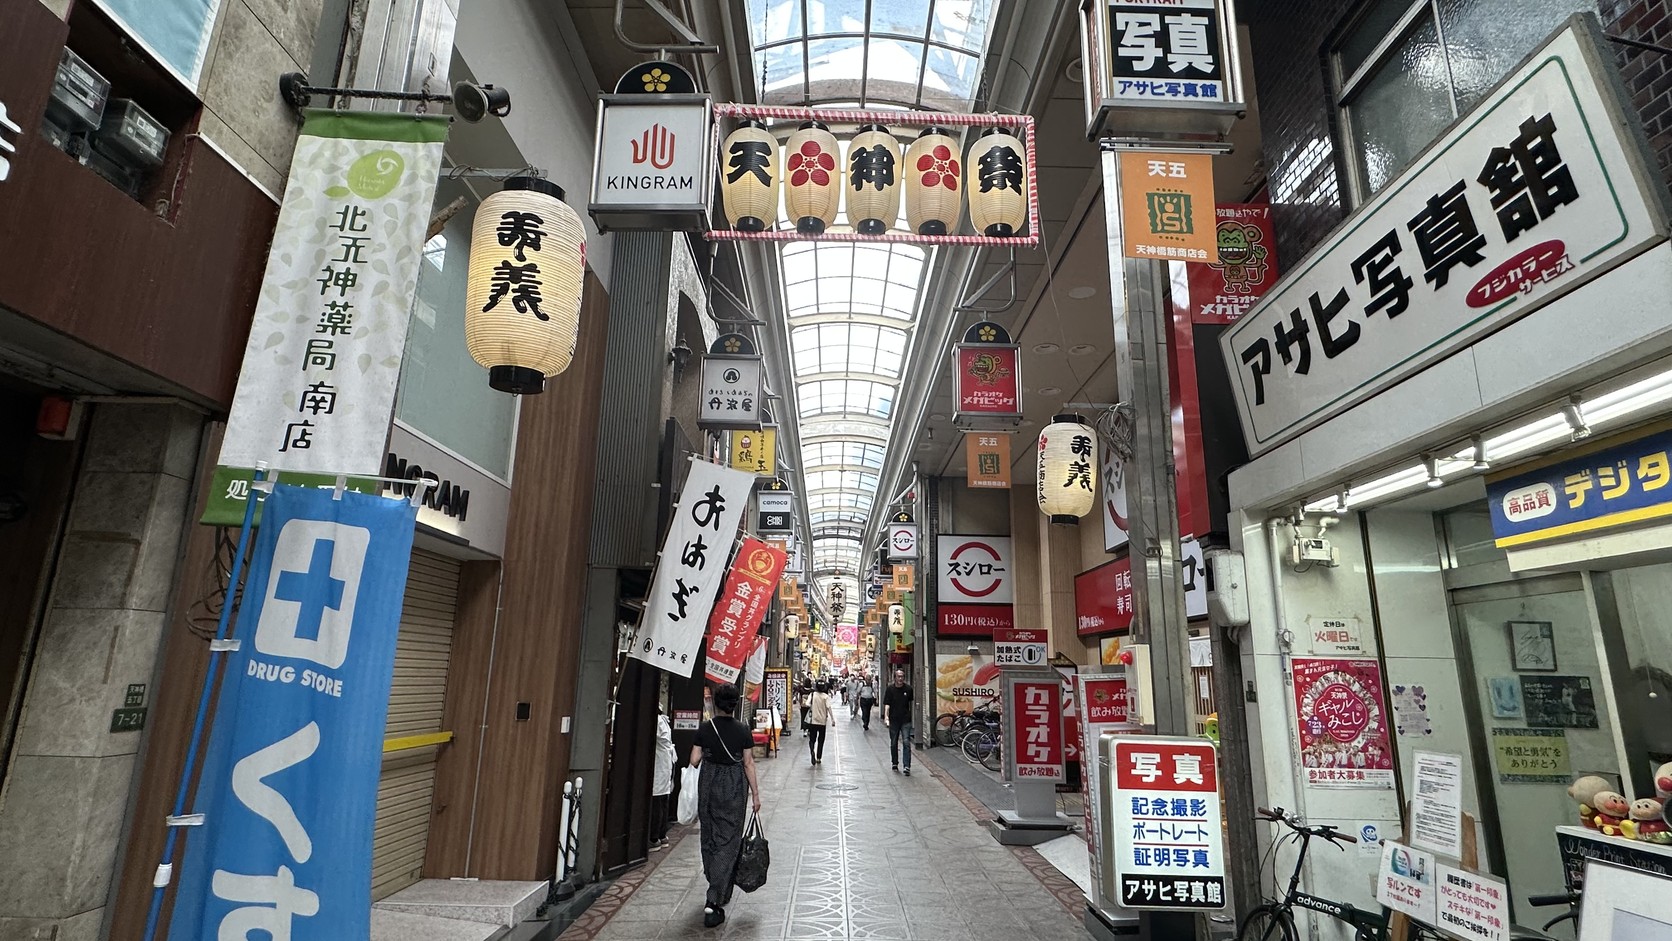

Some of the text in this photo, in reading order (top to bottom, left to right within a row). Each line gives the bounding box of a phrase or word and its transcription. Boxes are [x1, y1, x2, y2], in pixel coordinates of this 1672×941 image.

[1115, 12, 1216, 74] 写真
[1119, 80, 1218, 98] アサヒ写真館
[1147, 160, 1187, 178] 天五
[606, 176, 694, 190] KINGRAM
[1135, 244, 1209, 259] 天神橋筋商店会
[1241, 112, 1581, 406] アサヒ写真館
[1477, 246, 1553, 299] フジカラー
[1518, 256, 1574, 296] サービス
[1200, 303, 1250, 315] メガビ
[278, 204, 372, 453] 北五神薬局南店
[979, 437, 998, 446] 天五
[1508, 488, 1551, 516] 高品質
[892, 537, 915, 545] スシロー
[667, 484, 726, 622] おはぎ
[946, 562, 1006, 576] スシロー
[830, 582, 845, 613] 天神祭
[711, 581, 753, 655] 金賞受賞
[996, 645, 1022, 654] 加熱式
[247, 659, 344, 697] DRUG STORE
[952, 688, 995, 697] SUSHIRO
[1319, 700, 1355, 717] ギャル
[118, 713, 143, 725] 7-21
[1024, 686, 1051, 763] カラオケ
[1130, 753, 1205, 785] 写真
[1511, 759, 1558, 769] ありがとう
[1308, 770, 1365, 781] 参加者大募集
[1131, 797, 1208, 818] 記念撮影
[1133, 822, 1209, 842] ポートレート
[1133, 847, 1210, 869] 証明写真
[1125, 880, 1222, 904] アサヒ写真館
[1387, 876, 1422, 899] 写ルンです
[1297, 896, 1342, 914] advance
